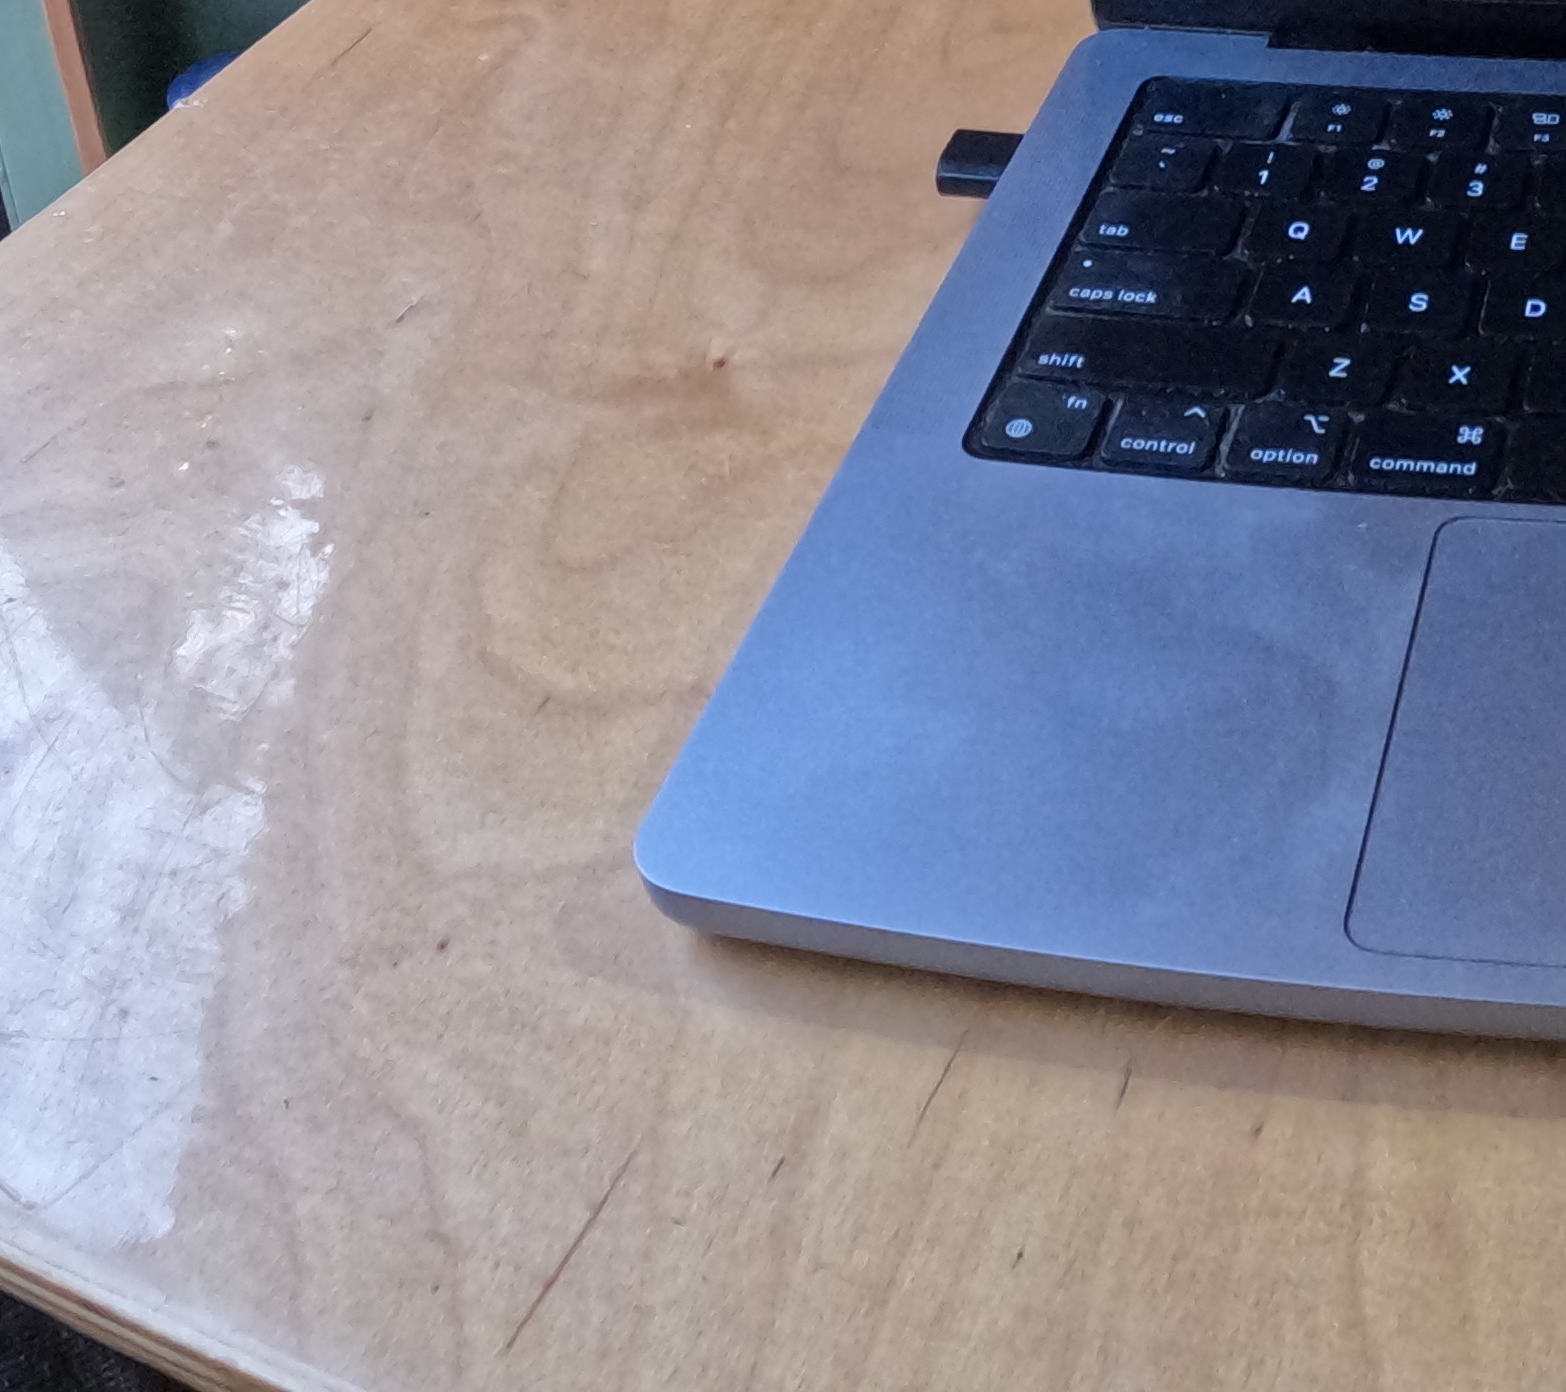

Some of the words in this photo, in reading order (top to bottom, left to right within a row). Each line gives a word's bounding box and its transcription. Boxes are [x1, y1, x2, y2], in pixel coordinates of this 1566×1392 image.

[1154, 113, 1183, 123] esc
[1327, 124, 1342, 132] F1
[1259, 170, 1269, 184] 1
[1361, 175, 1378, 191] 2
[1467, 180, 1484, 197] 3
[1099, 224, 1129, 237] tab
[1288, 221, 1310, 240] Q
[1395, 227, 1423, 245] W
[1510, 232, 1528, 250] E
[1068, 287, 1114, 301] caps
[1118, 288, 1158, 304] lock
[1291, 286, 1312, 304] A
[1408, 292, 1429, 312] S
[1524, 298, 1547, 317] D
[1038, 353, 1084, 368] shift
[1329, 357, 1351, 378] Z
[1448, 365, 1471, 385] X
[1066, 395, 1089, 410] fn
[1121, 438, 1195, 454] control
[1250, 448, 1319, 464] option
[1369, 457, 1477, 476] command
